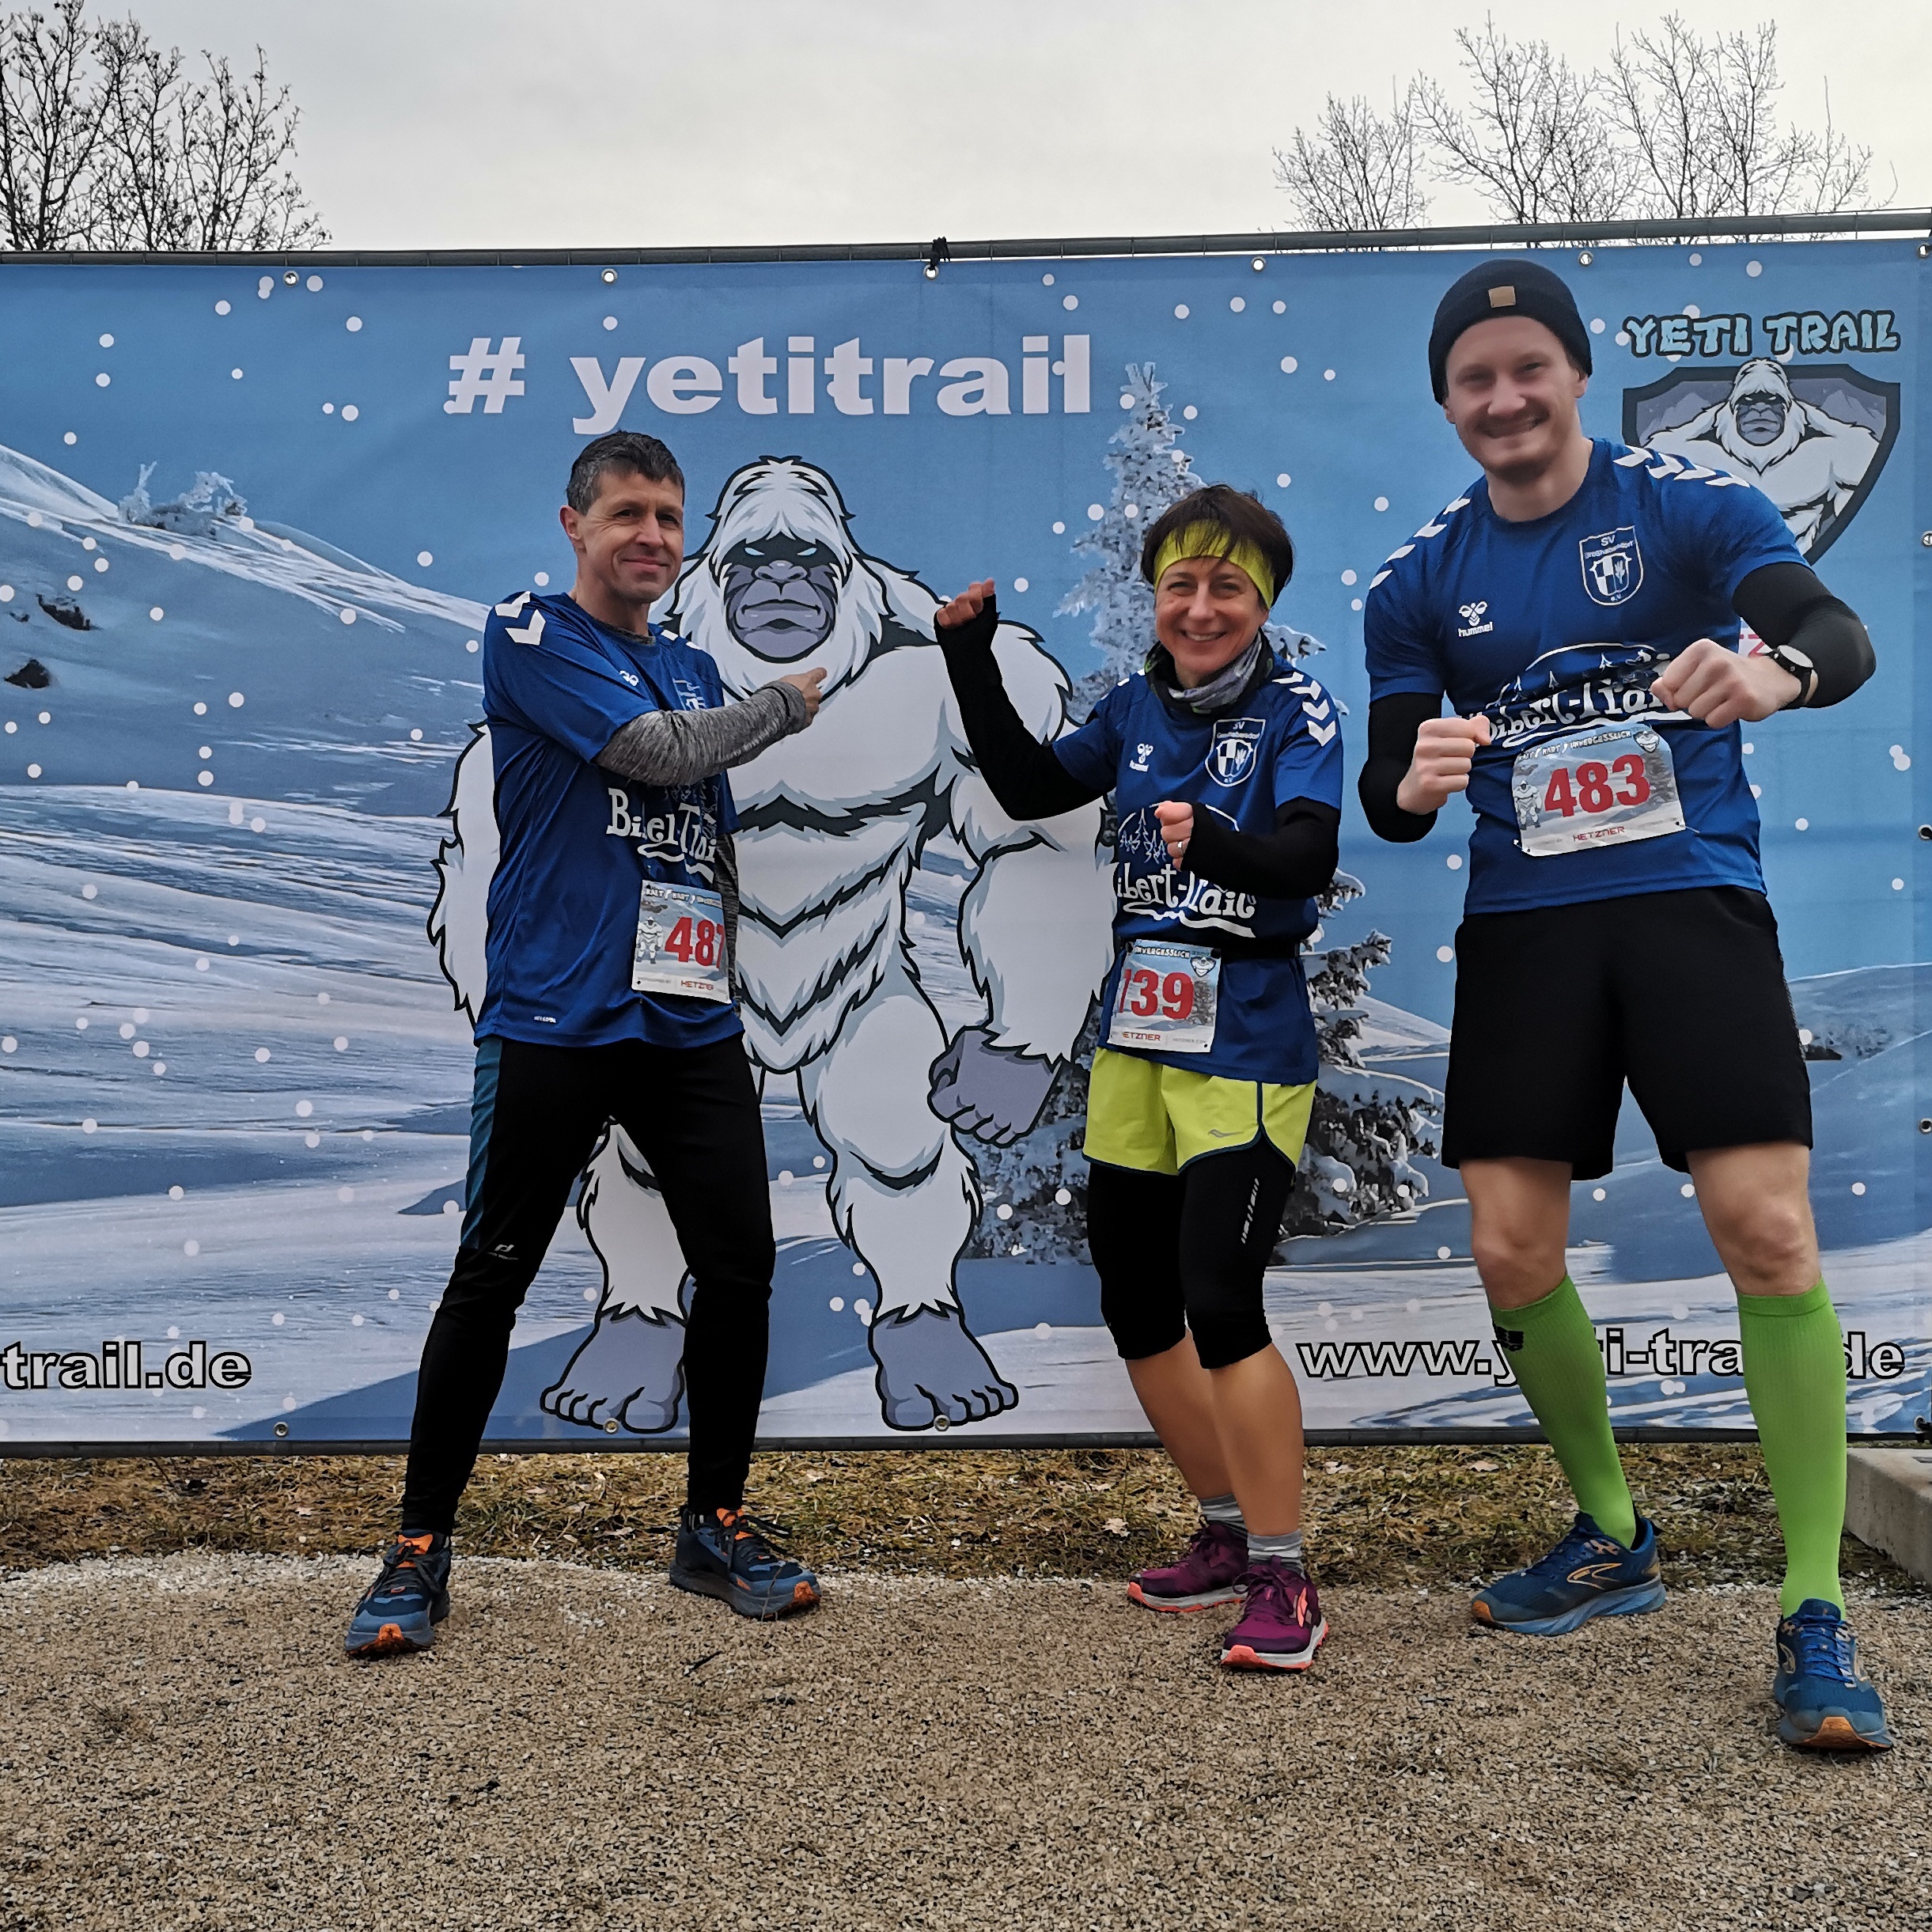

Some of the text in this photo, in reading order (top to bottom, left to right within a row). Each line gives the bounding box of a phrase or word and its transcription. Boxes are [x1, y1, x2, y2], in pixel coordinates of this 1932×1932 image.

[1623, 310, 1900, 357] YETI TRAIL
[445, 335, 1090, 434] # yetitrail
[1601, 535, 1615, 546] SV
[1458, 621, 1493, 637] hummel
[1233, 722, 1245, 730] SV
[1545, 754, 1650, 817] 483
[1573, 827, 1624, 841] HETZNER
[1121, 1031, 1161, 1041] ETZNER
[0, 1340, 252, 1389] trail.de
